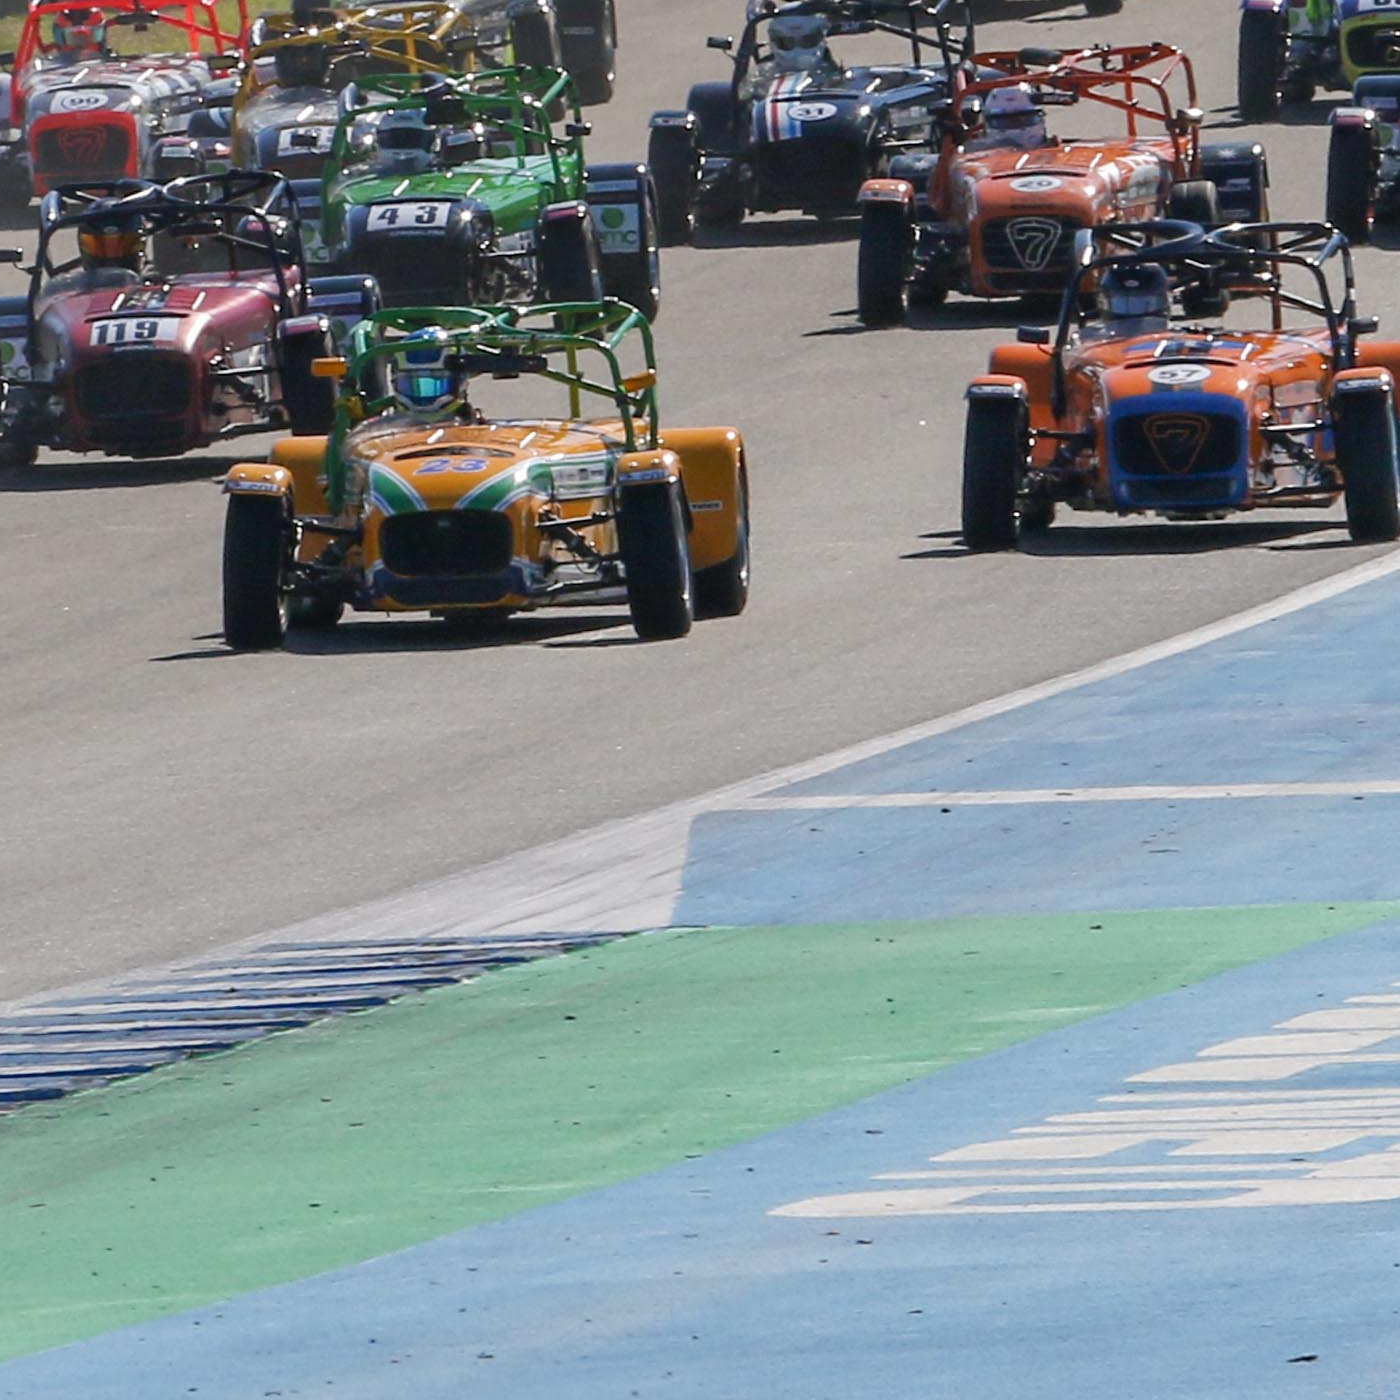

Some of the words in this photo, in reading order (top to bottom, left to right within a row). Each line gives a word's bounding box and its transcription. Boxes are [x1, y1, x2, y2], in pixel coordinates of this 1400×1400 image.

[70, 96, 100, 105] 99
[377, 206, 440, 225] 43
[1014, 223, 1054, 264] 7
[95, 320, 159, 345] 119
[1159, 369, 1202, 378] 57
[413, 458, 489, 475] 23
